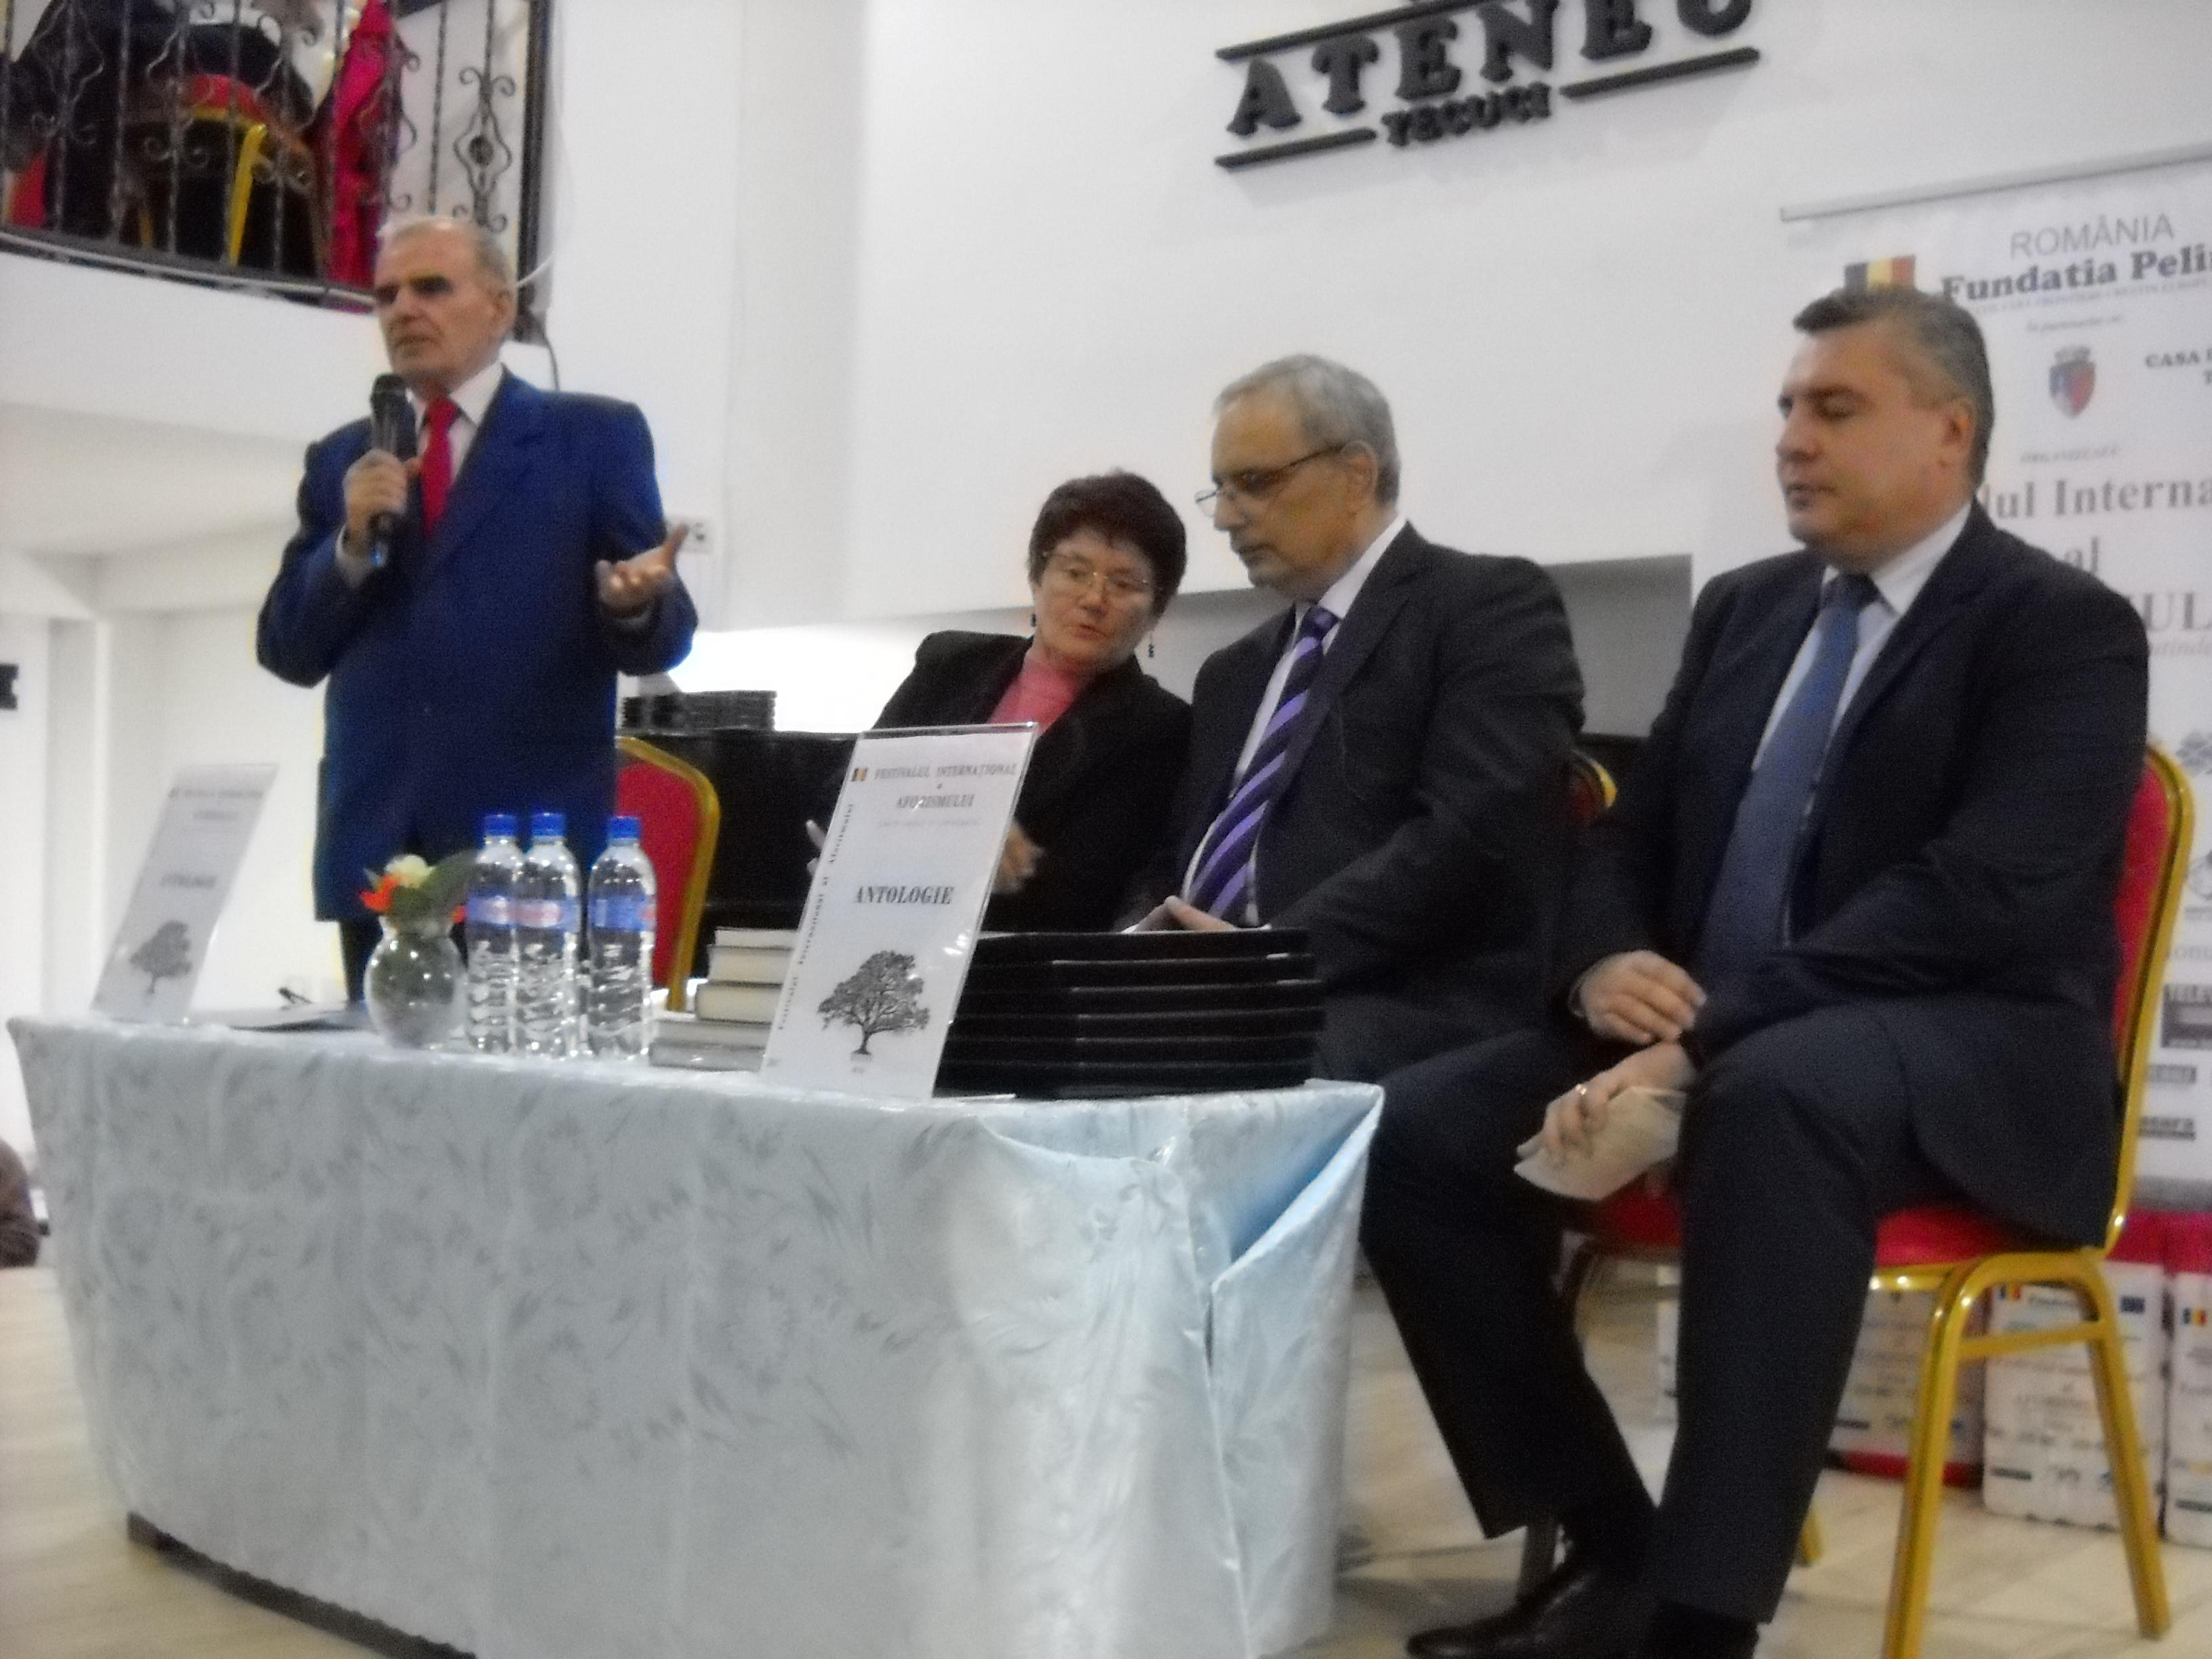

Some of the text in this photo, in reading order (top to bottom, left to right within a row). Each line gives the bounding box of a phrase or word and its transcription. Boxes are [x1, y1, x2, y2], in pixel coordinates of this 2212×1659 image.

[2010, 213, 2174, 259] ROMÂNIA
[2131, 243, 2212, 281] Peli
[2144, 350, 2200, 368] CASA
[853, 885, 954, 905] ANTOLOGIE
